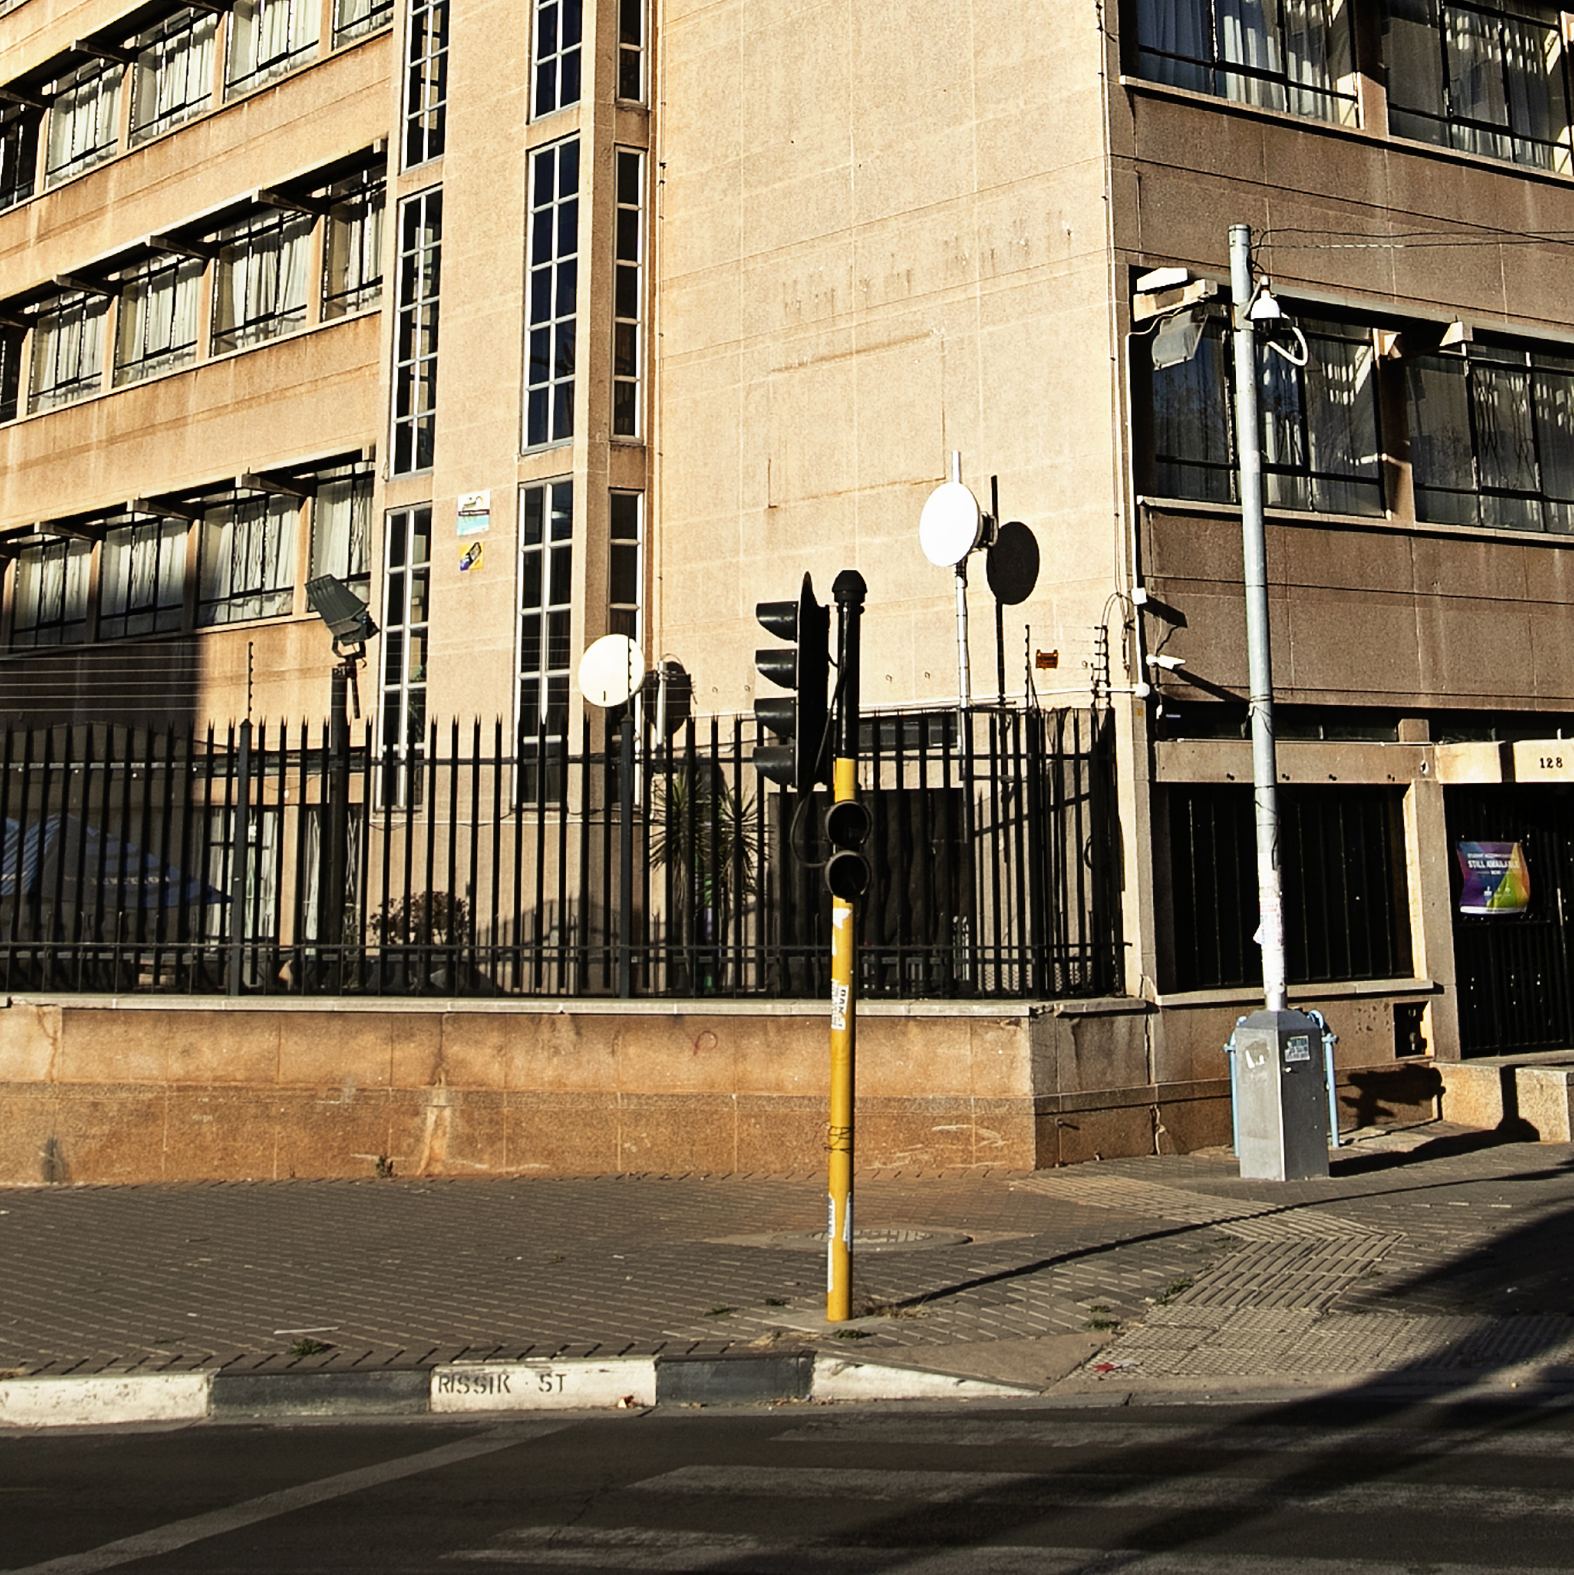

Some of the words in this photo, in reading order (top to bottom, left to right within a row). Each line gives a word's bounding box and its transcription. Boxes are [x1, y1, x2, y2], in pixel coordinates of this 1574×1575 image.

[1539, 757, 1563, 769] 128
[438, 1373, 511, 1395] RISSIK
[538, 1372, 567, 1393] ST
